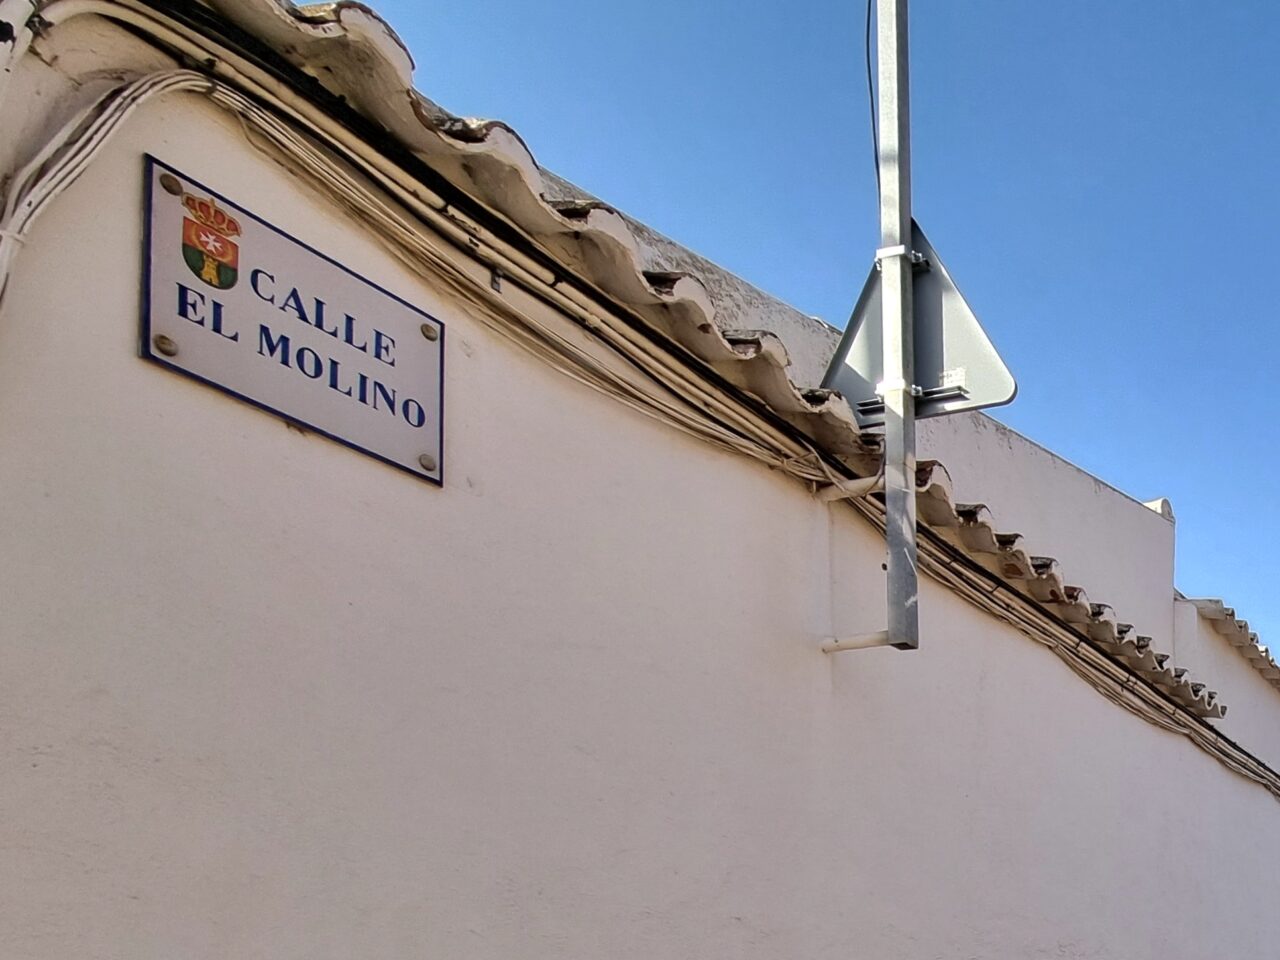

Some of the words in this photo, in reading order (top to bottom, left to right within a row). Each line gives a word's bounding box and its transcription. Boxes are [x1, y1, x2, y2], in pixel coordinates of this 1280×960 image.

[176, 282, 239, 342] EL
[257, 323, 425, 428] MOLINO
[250, 268, 396, 367] CALLE
